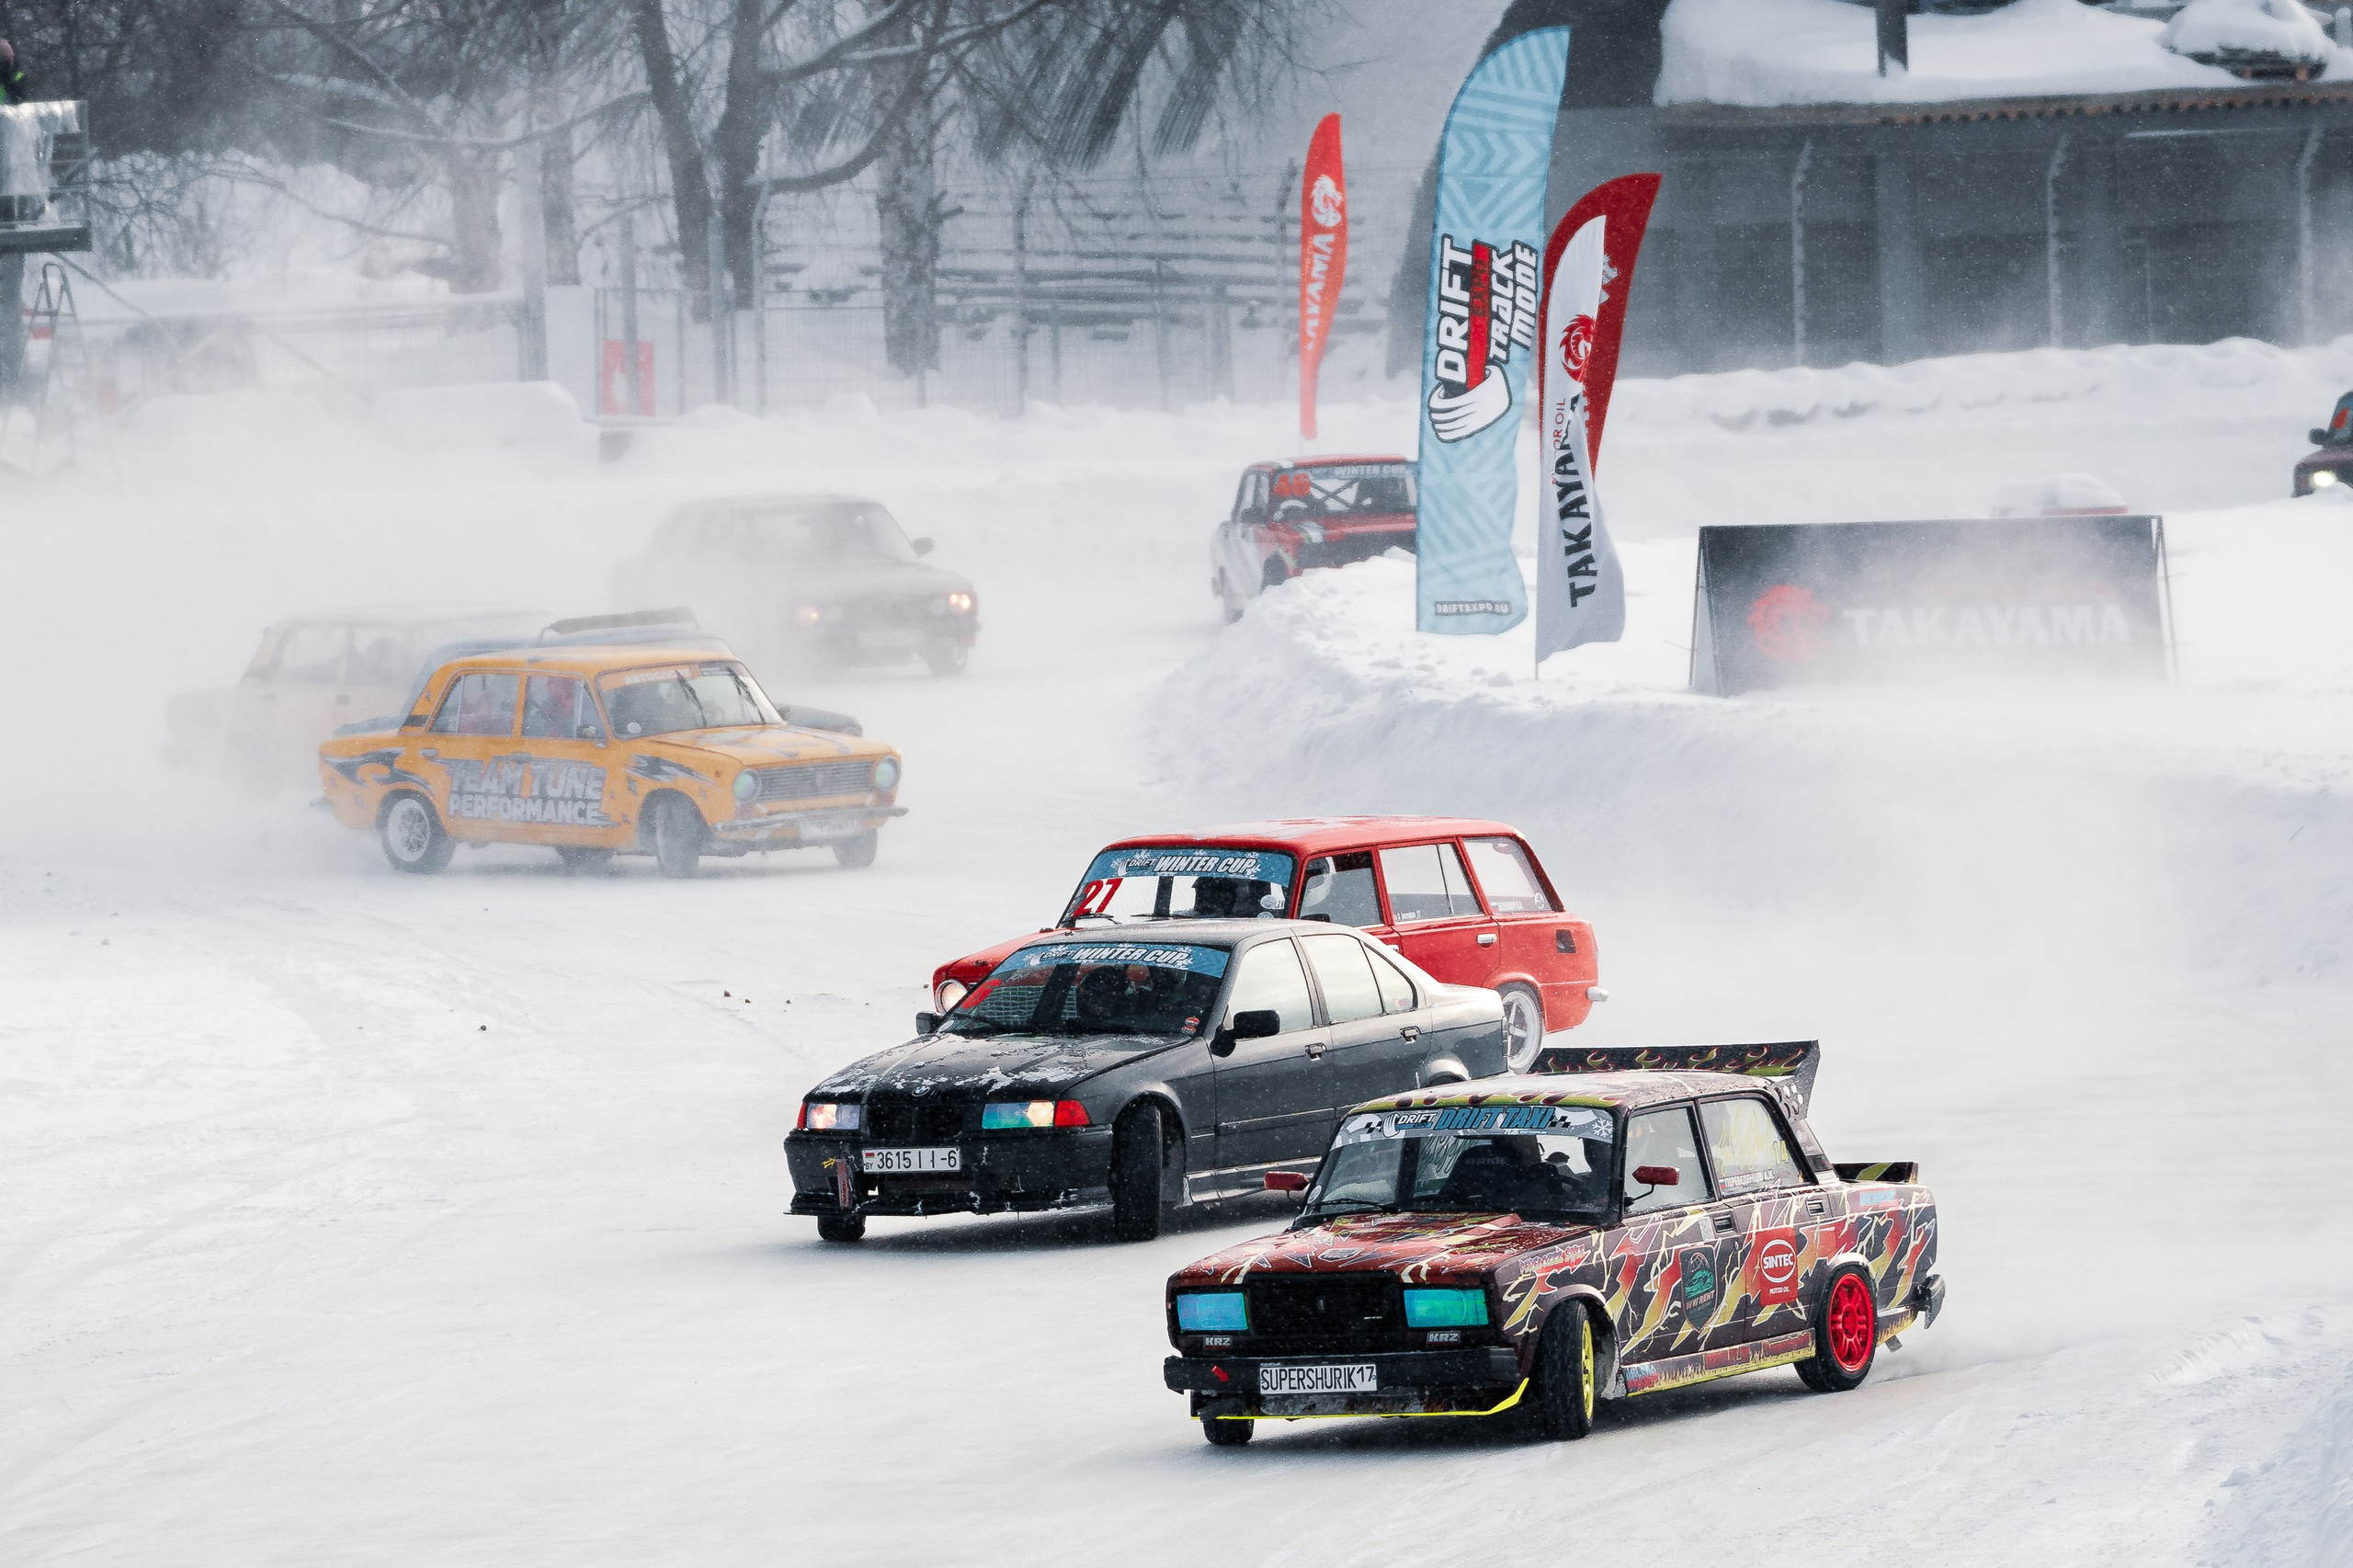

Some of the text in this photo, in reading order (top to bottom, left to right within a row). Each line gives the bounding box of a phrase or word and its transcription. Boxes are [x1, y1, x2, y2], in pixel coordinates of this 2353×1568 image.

[1436, 235, 1472, 386] DRIFT
[1555, 398, 1566, 424] OIL
[1436, 602, 1509, 614] DRIFTEXPO.RU
[1844, 604, 2133, 646] TAKAYAMA
[447, 759, 607, 801] TEAM TUNE
[449, 794, 611, 826] PERFORMANCE
[1154, 856, 1220, 872] WINTER
[1216, 858, 1257, 873] CUP
[1073, 878, 1123, 917] 27
[1071, 948, 1147, 960] WINTER
[1142, 949, 1189, 964] CUP
[1398, 1106, 1556, 1131] DRIFT DRIFT TAXI
[877, 1151, 912, 1169] 3615
[1763, 1253, 1794, 1269] SINTEC
[1205, 1336, 1231, 1346] KRZ
[1427, 1333, 1459, 1343] KRZ
